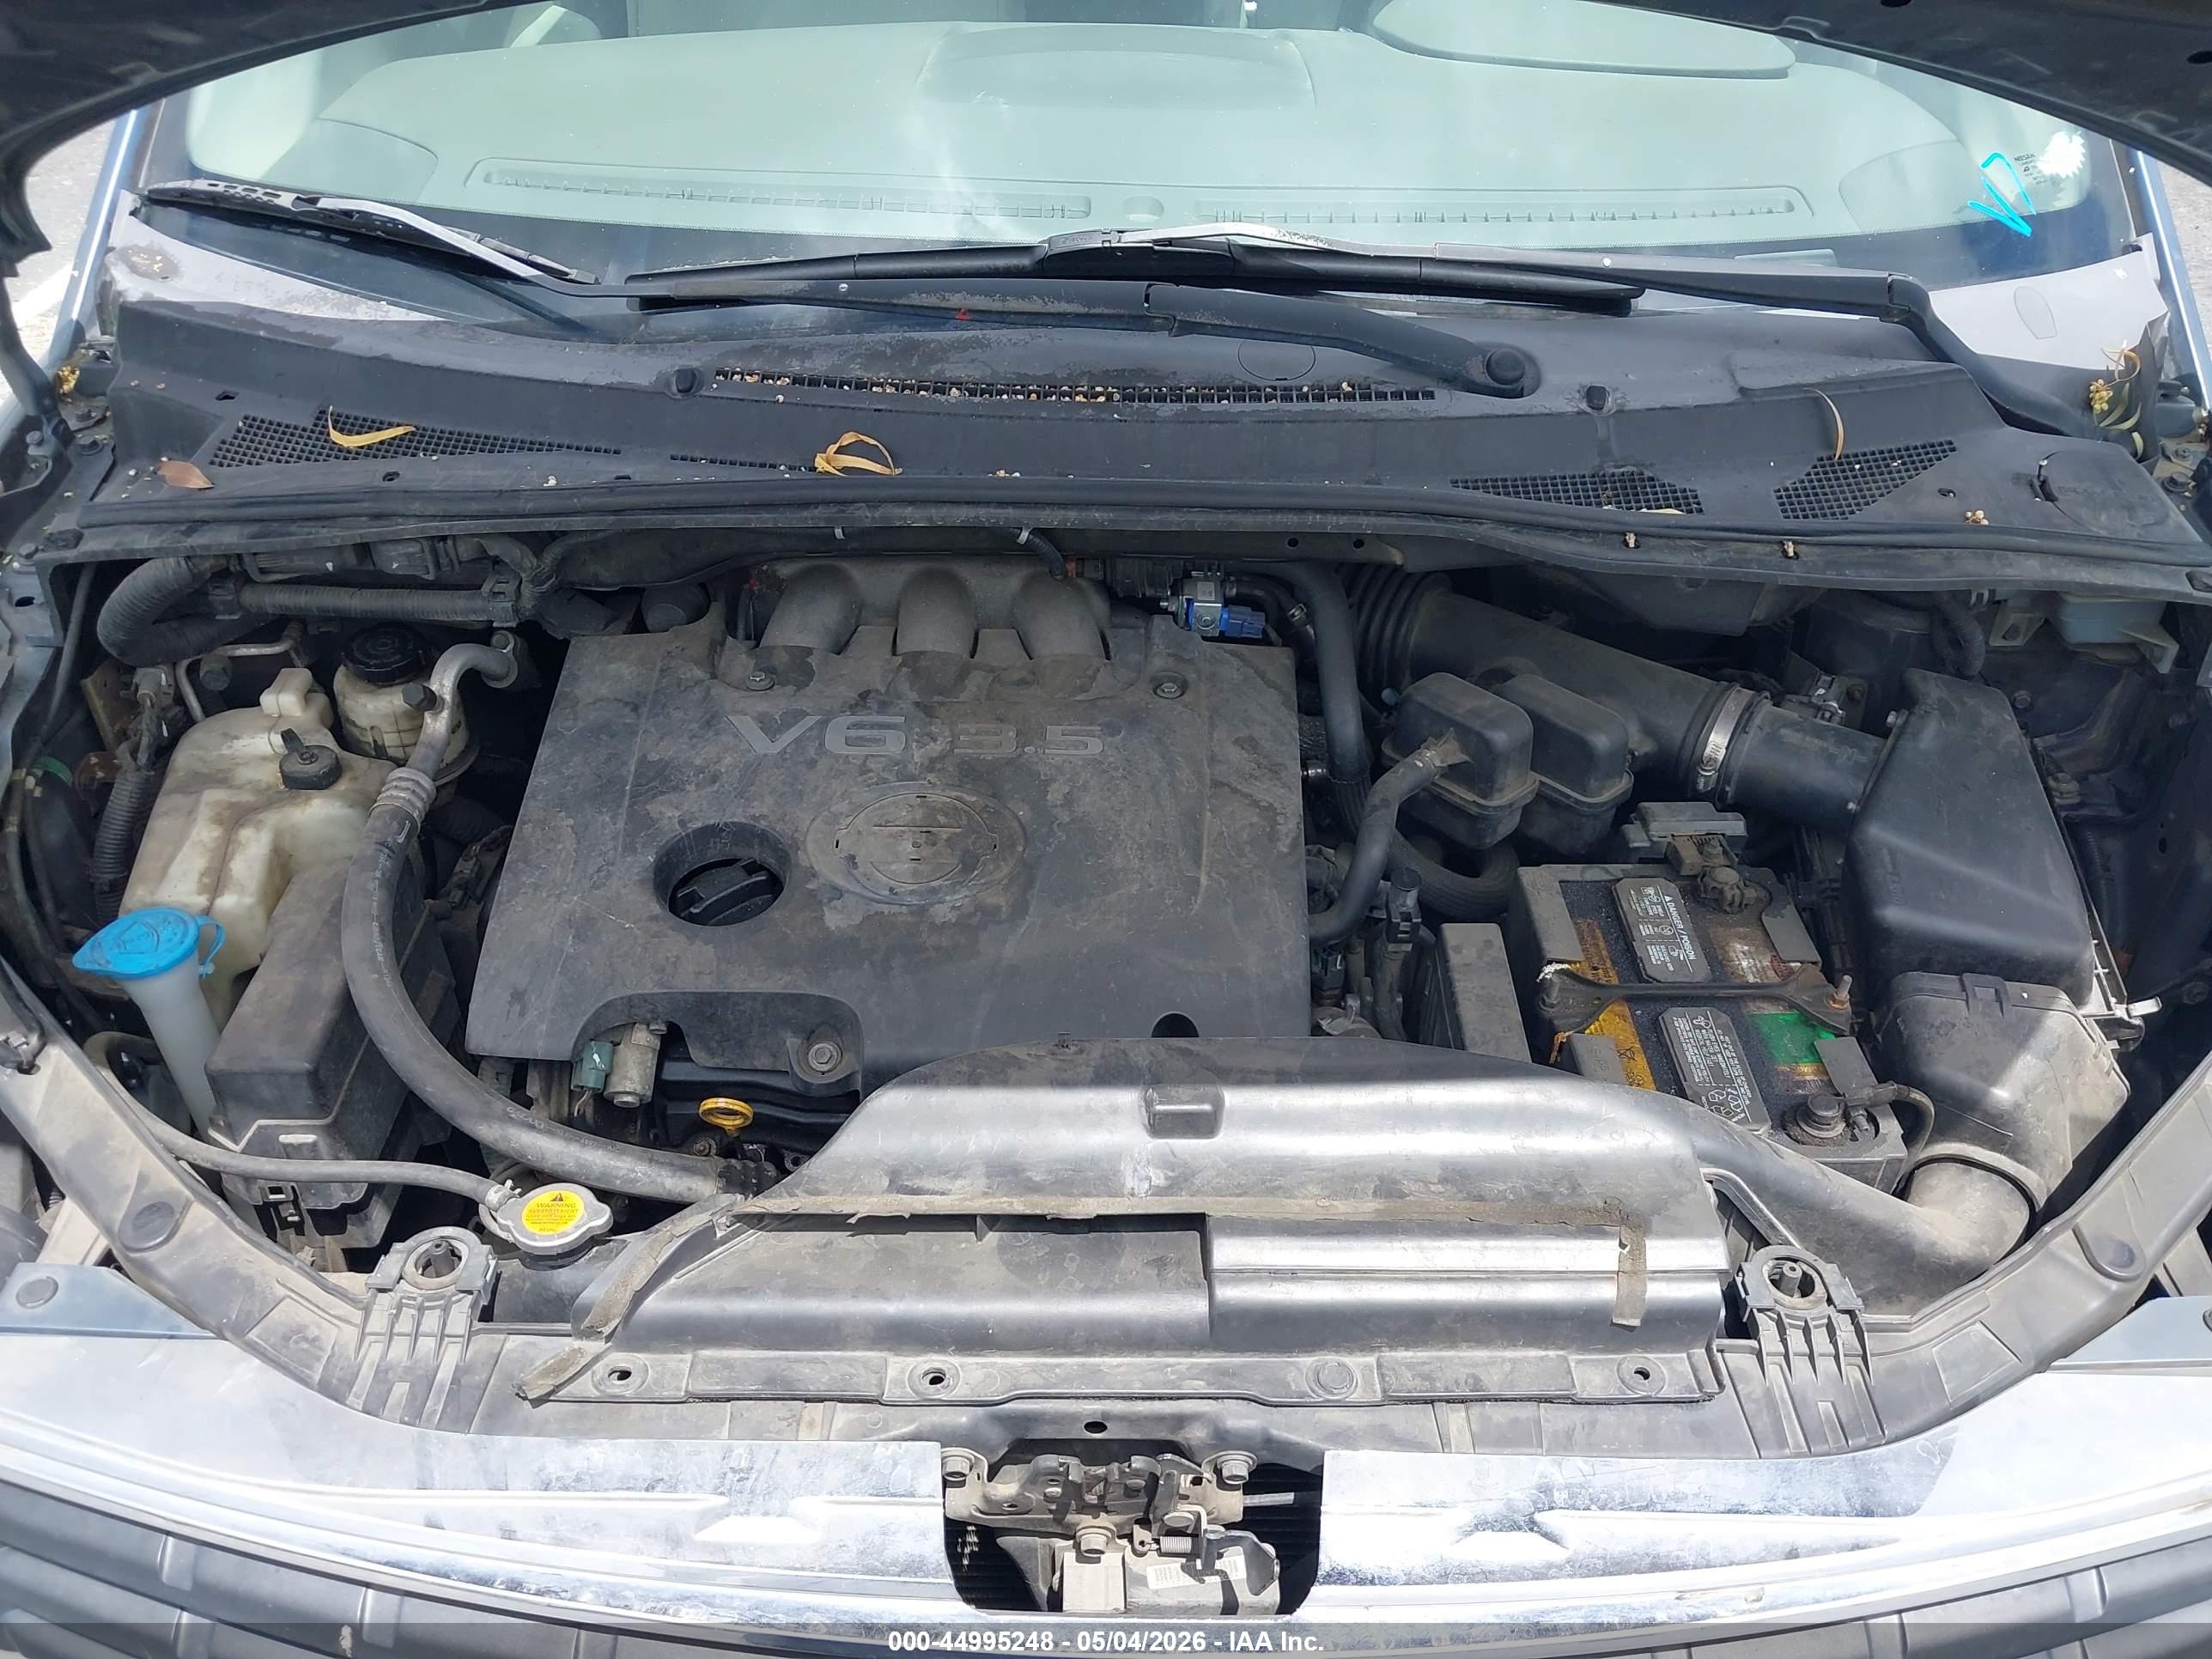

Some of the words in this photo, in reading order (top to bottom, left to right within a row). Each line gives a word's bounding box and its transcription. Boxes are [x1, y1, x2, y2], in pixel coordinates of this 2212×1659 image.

[725, 715, 907, 756] V6
[953, 723, 1104, 756] 3.5
[1667, 902, 1683, 929] DANGER
[1680, 935, 1697, 960] POISON
